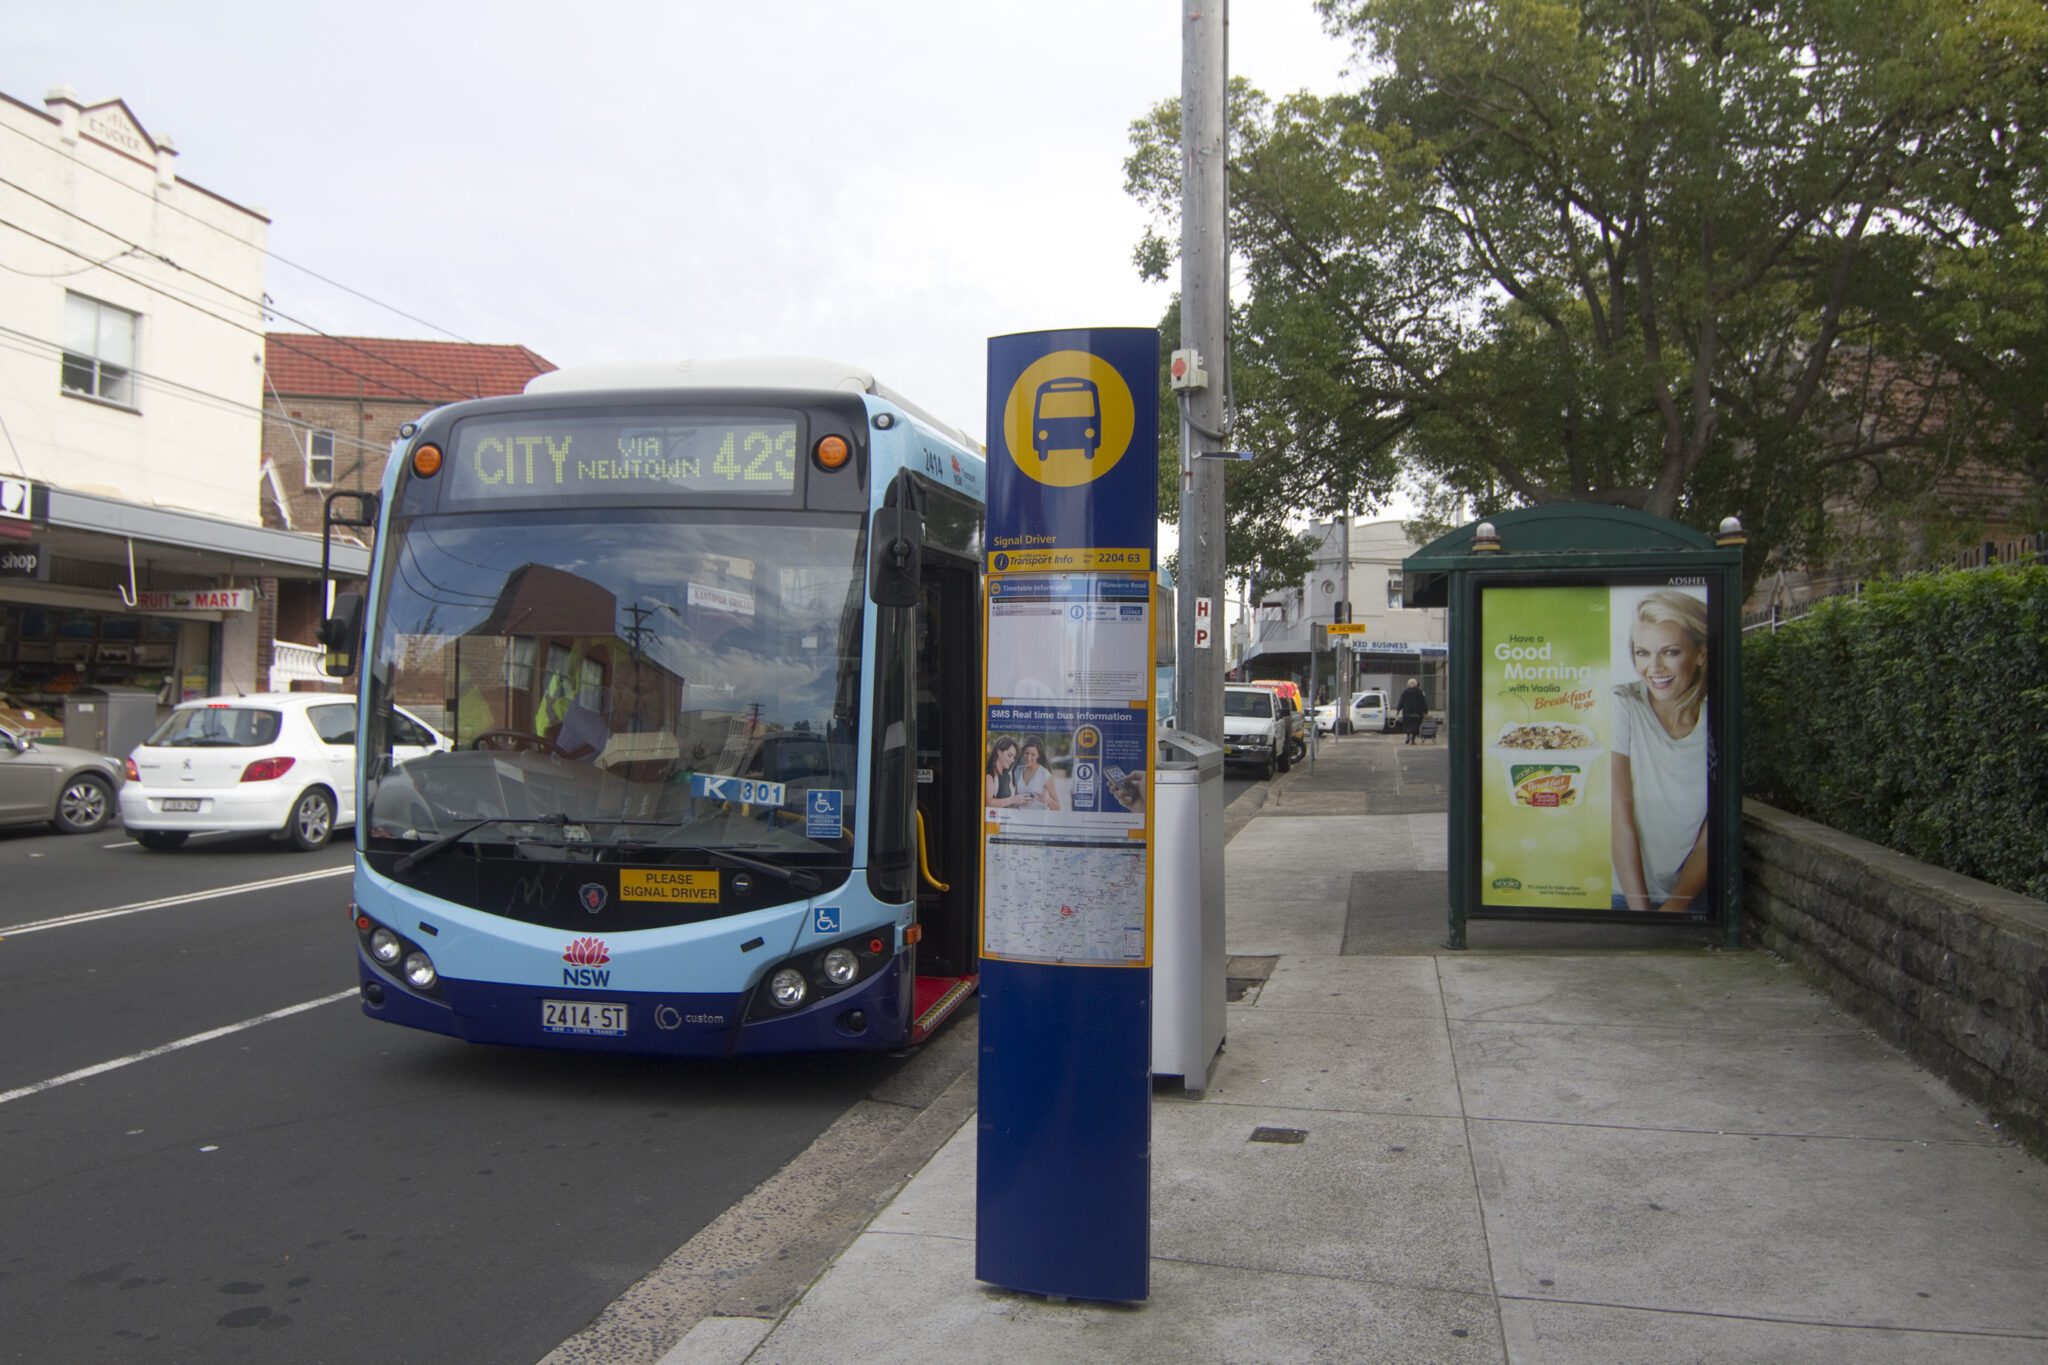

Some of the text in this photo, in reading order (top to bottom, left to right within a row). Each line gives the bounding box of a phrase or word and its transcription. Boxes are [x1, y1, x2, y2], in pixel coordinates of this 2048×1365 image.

[474, 431, 796, 484] CITY VIA NEWTOWN 423
[923, 448, 943, 478] 2414
[994, 535, 1057, 548] Signal Driver
[2, 552, 37, 573] shop
[1009, 554, 1073, 567] Transport Info
[1098, 553, 1141, 563] 2204 63
[1002, 583, 1073, 592] Timetable Information
[1130, 581, 1147, 589] Road
[138, 592, 240, 608] RUIT MART
[1196, 602, 1208, 645] H P
[1372, 641, 1408, 649] BUSINESS
[1509, 635, 1535, 643] Have
[1494, 641, 1552, 661] Good
[1503, 661, 1592, 684] Morning
[1509, 684, 1561, 693] with Vaalia
[1534, 689, 1593, 710] Breakfast
[991, 709, 1132, 721] SMS Real time bus information
[703, 777, 782, 804] K 301
[646, 873, 693, 885] PLEASE
[623, 886, 717, 899] SIGNAL DRIVER
[563, 968, 611, 988] NSW
[546, 1004, 623, 1028] 2414-ST
[685, 1012, 725, 1024] custom
